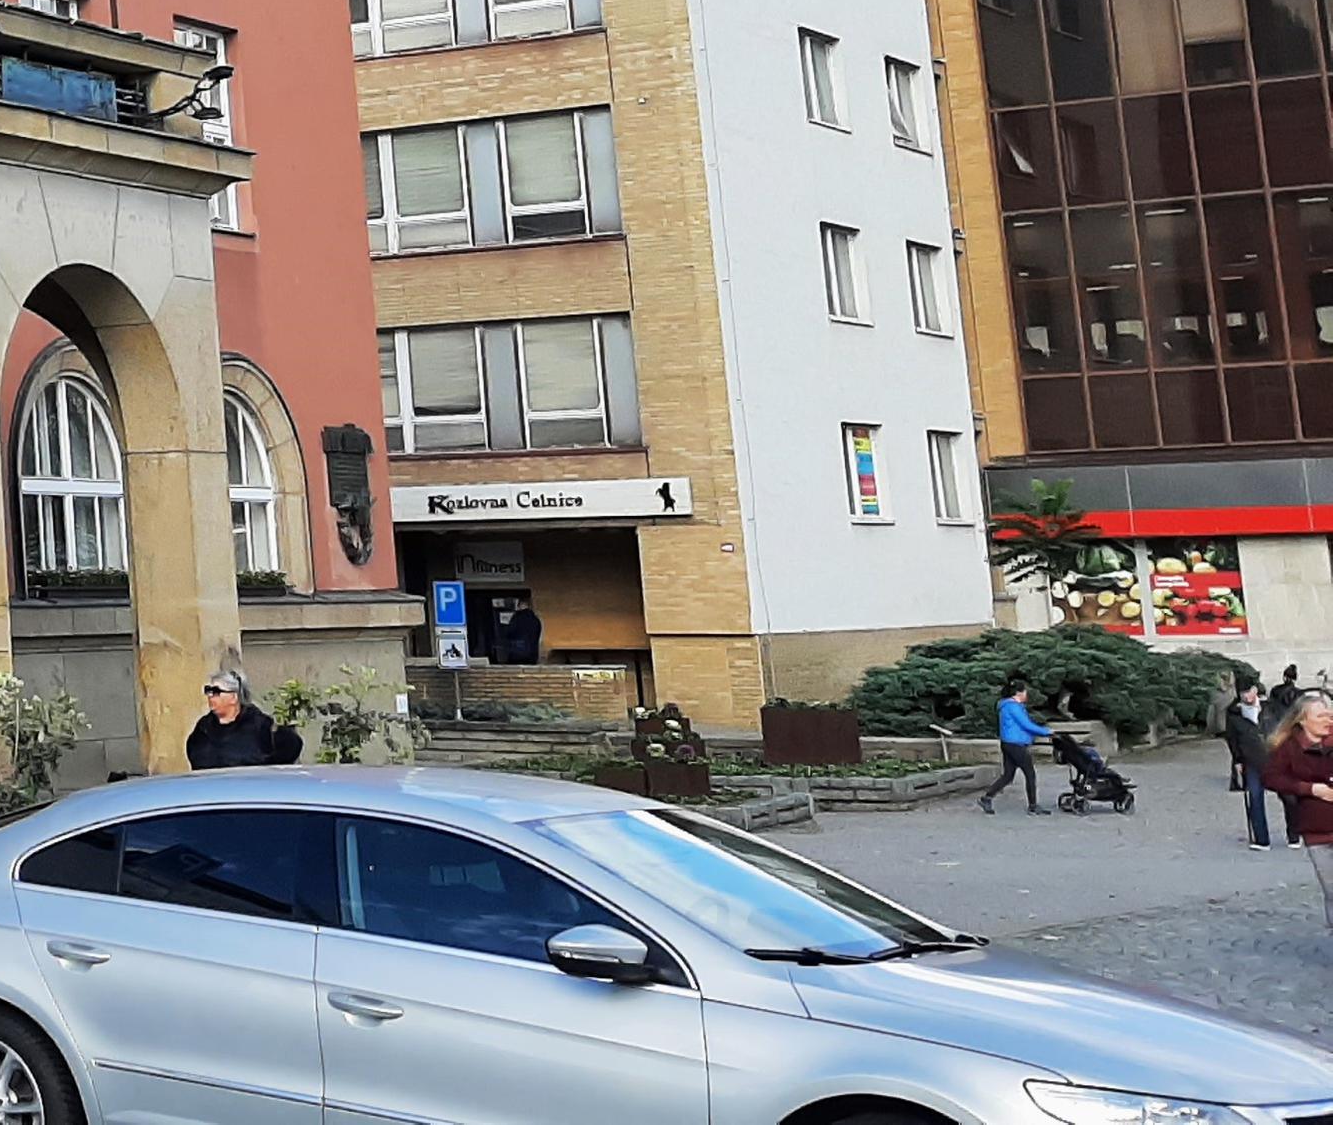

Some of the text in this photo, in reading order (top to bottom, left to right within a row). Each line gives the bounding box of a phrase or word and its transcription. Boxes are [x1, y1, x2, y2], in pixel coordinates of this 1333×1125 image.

[427, 491, 584, 515] Kozlovna Celnice
[439, 586, 458, 612] P
